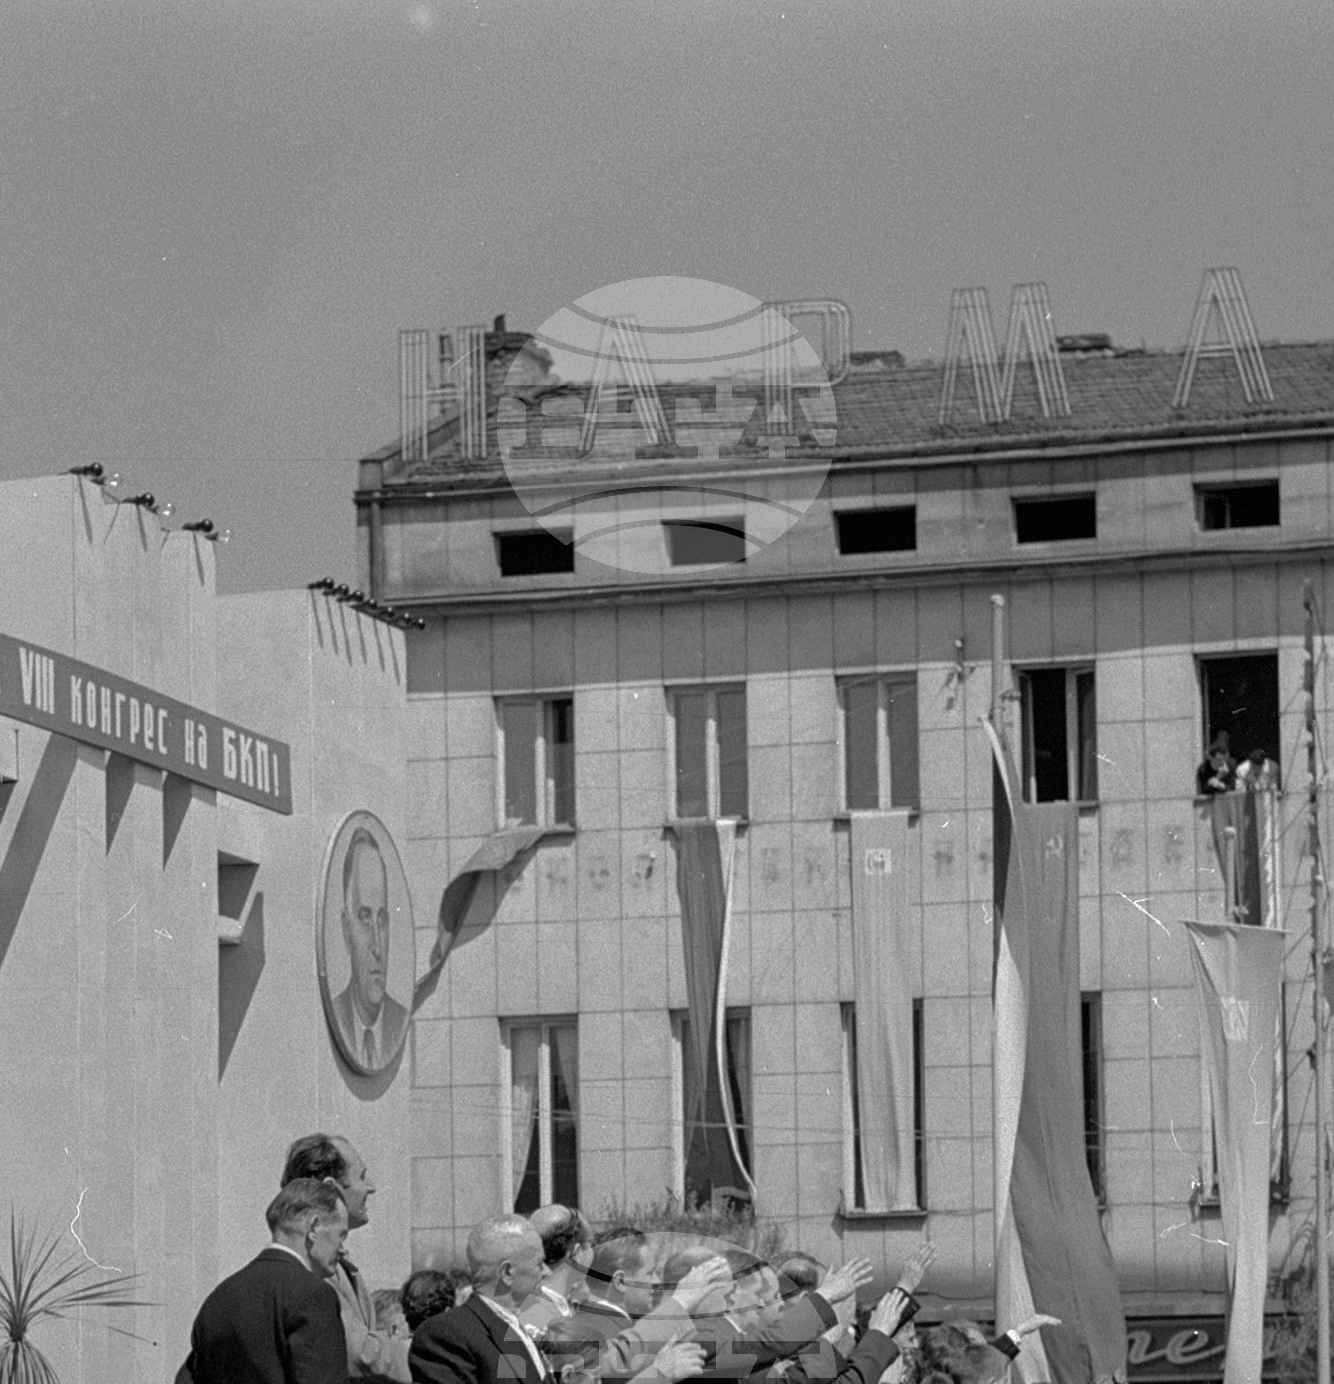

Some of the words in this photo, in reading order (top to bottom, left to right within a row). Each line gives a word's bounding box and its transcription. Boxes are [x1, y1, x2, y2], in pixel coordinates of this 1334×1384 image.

[18, 646, 56, 715] VIII
[69, 673, 168, 756] конгрес
[183, 717, 209, 771] на
[221, 725, 281, 797] БКП!
